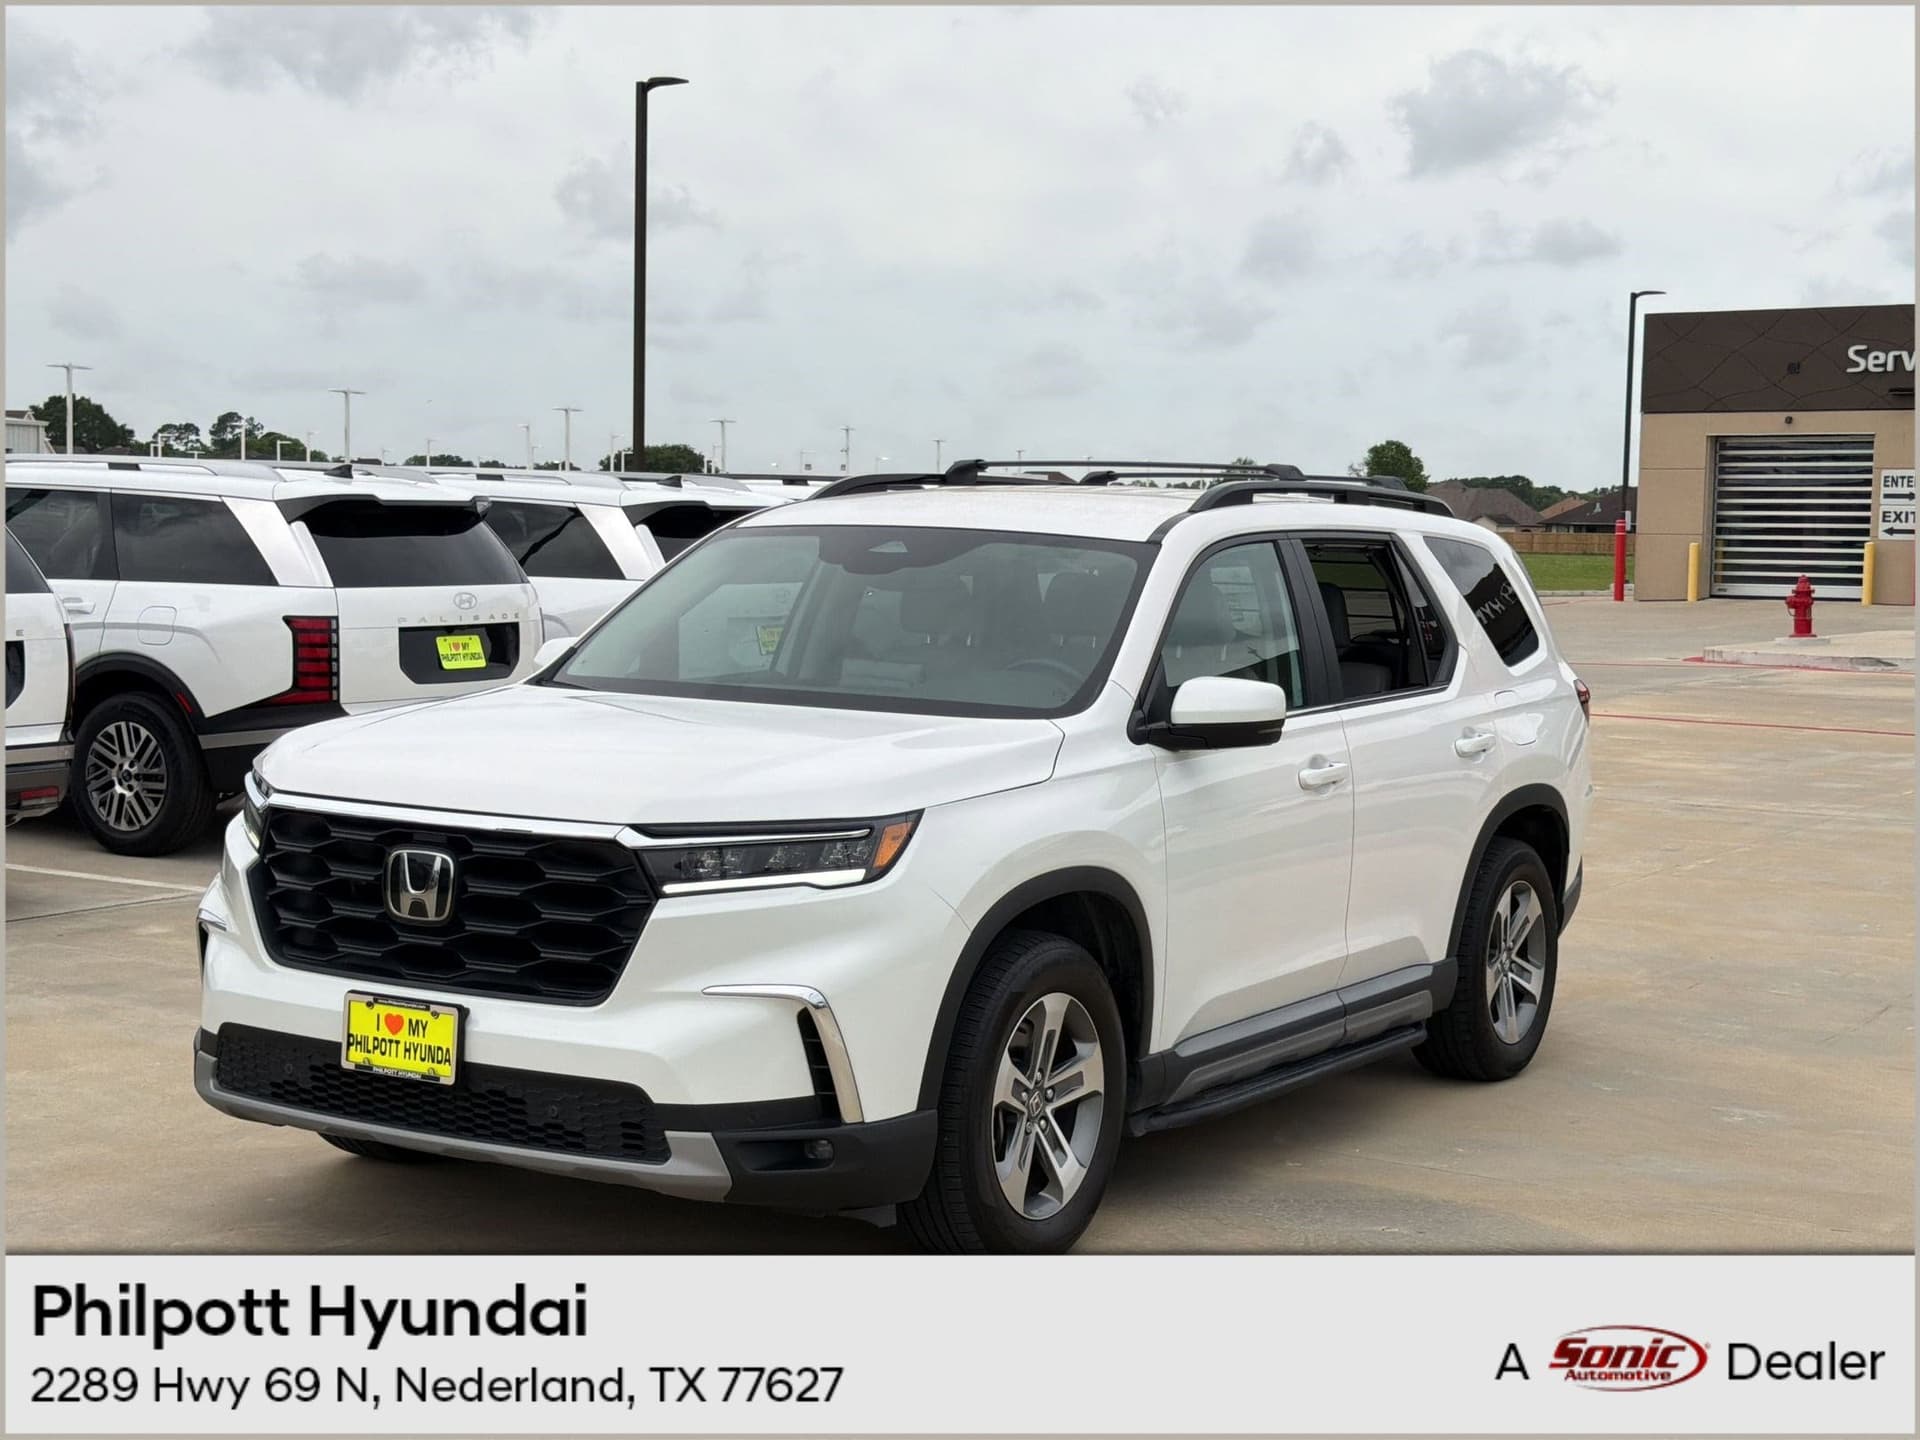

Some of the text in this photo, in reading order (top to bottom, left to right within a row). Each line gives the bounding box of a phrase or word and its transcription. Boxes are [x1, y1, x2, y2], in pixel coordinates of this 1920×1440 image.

[1883, 475, 1915, 488] ENTE
[398, 612, 519, 623] PALISADE
[376, 1013, 428, 1038] I MY
[347, 1033, 400, 1058] PHILPOTT
